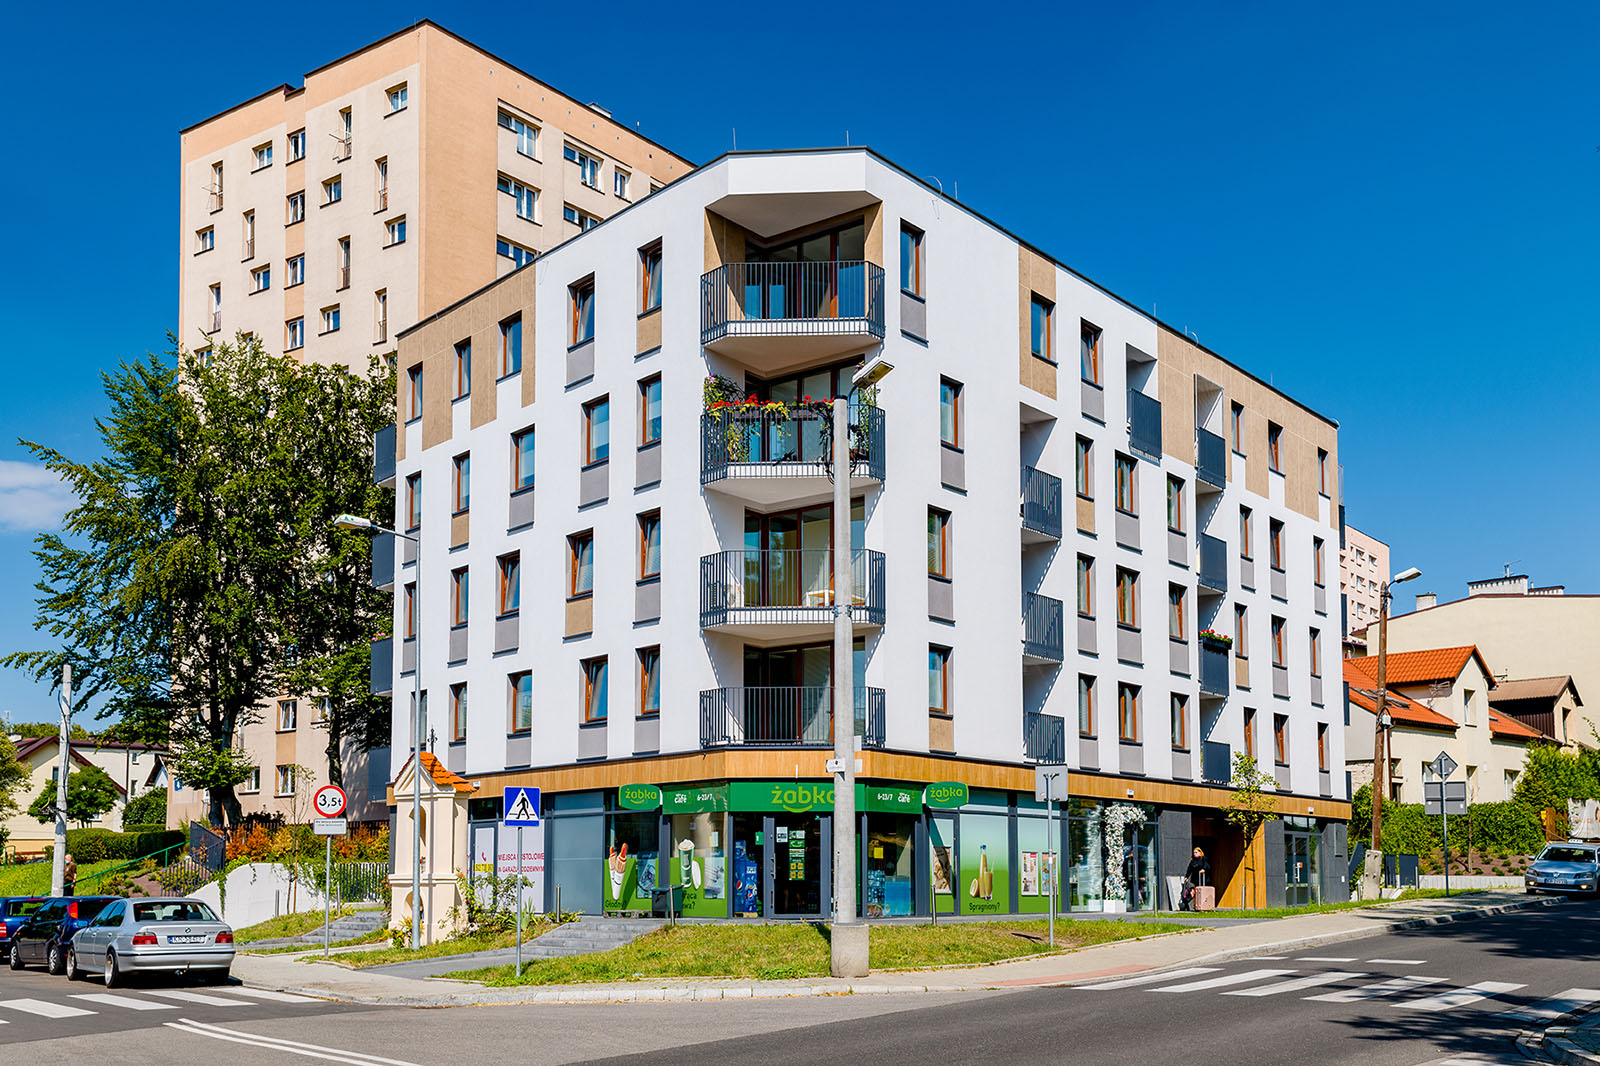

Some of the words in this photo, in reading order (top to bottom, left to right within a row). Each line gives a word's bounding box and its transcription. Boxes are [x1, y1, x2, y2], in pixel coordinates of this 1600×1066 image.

[625, 788, 657, 800] żabka
[771, 786, 834, 804] żabka
[930, 787, 963, 798] żabka
[517, 852, 544, 861] STOJOWE
[969, 902, 1001, 913] Spragniony?
